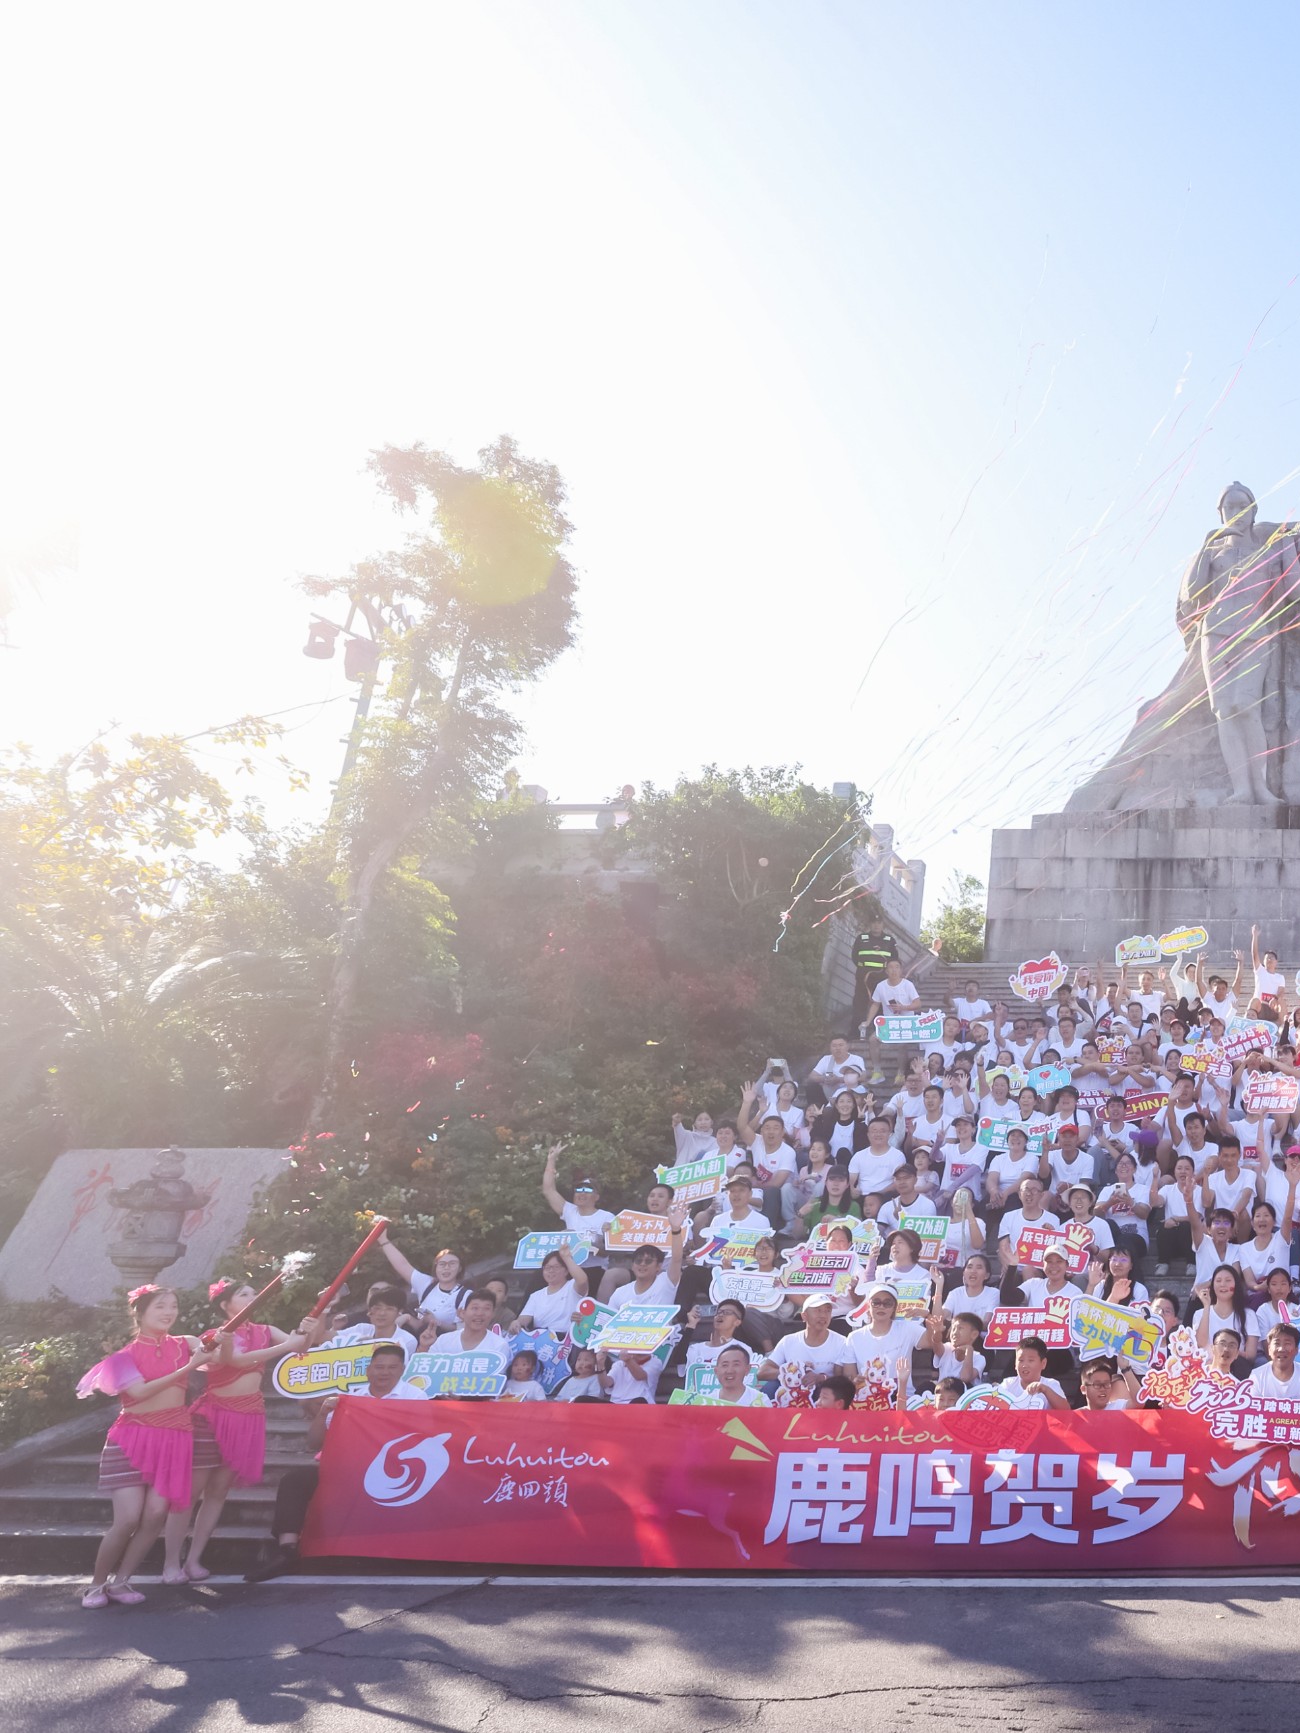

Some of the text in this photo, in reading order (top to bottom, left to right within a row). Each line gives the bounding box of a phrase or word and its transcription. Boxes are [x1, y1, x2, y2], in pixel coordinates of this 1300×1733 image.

[1022, 971, 1054, 986] 我爱你
[1027, 985, 1049, 999] 中国
[1181, 1055, 1232, 1077] 欢度元旦
[1251, 1081, 1278, 1094] 一马当先
[1251, 1095, 1289, 1110] 勇闯新局
[666, 1160, 721, 1185] 全力以赴
[674, 1180, 715, 1203] 持到底
[632, 1219, 666, 1231] 为不凡
[904, 1218, 945, 1236] 全力以赴
[621, 1233, 668, 1244] 突破极限
[806, 1255, 850, 1270] 趣运动
[726, 1277, 775, 1290] 友谊第一
[789, 1271, 833, 1286] 型动派
[617, 1310, 669, 1323] 生命不息
[995, 1312, 1046, 1324] 跃马扬鞭
[1077, 1300, 1130, 1333] 满怀激情
[609, 1330, 663, 1346] 运动不止
[288, 1356, 368, 1387] 奔跑向未
[412, 1356, 490, 1374] 活力就是
[439, 1376, 498, 1393] 战斗力
[1190, 1380, 1254, 1416] 2026
[783, 1412, 954, 1445] Luhuitou
[1215, 1412, 1269, 1439] 完胜
[1276, 1417, 1299, 1426] GREAT
[463, 1435, 610, 1469] Luhuitou
[764, 1448, 1186, 1546] 鹿鸣贺岁
